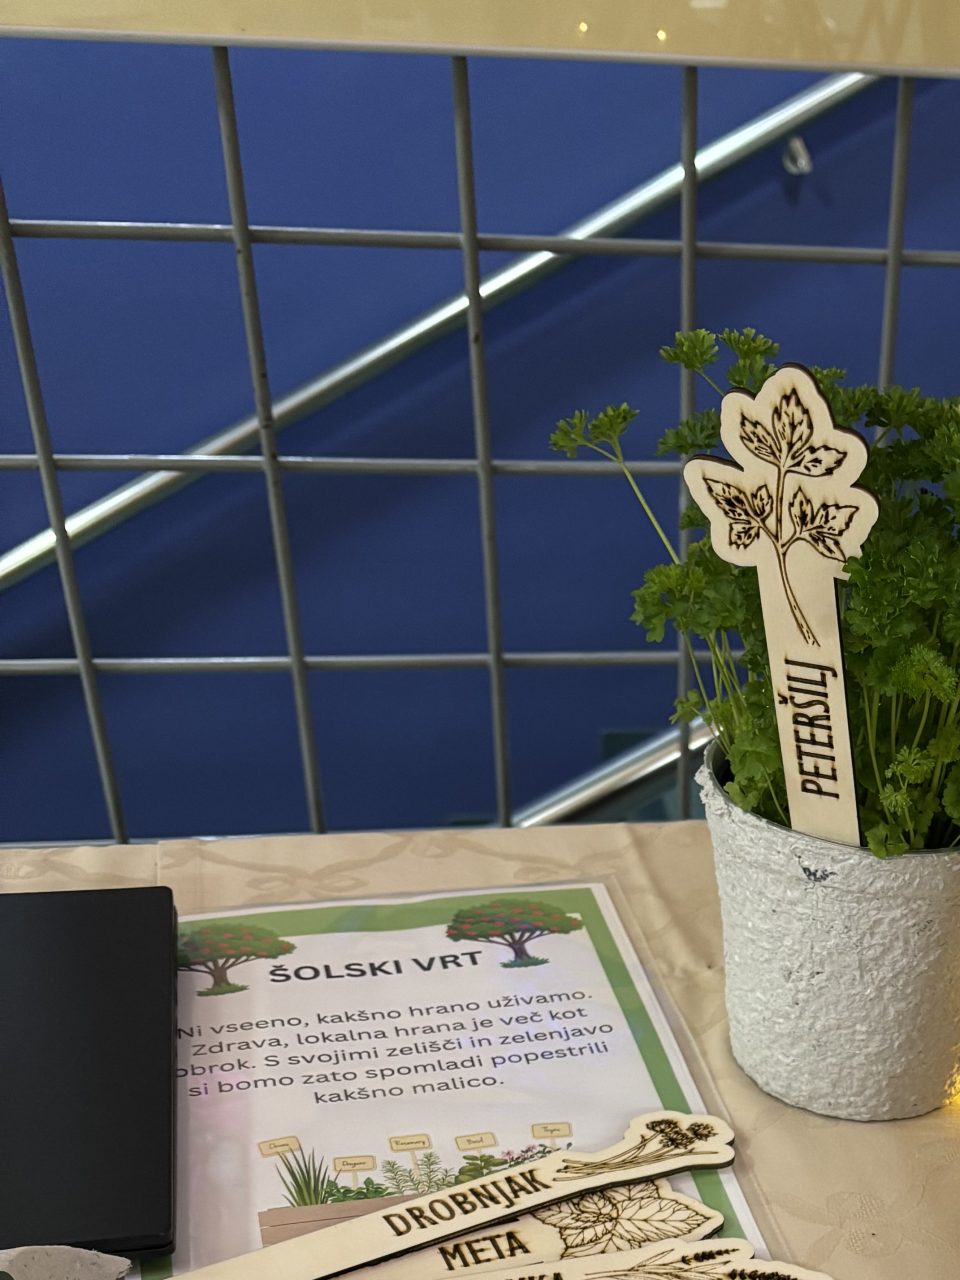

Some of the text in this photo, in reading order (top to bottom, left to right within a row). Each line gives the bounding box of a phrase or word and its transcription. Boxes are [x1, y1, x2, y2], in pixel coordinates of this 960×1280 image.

[778, 659, 840, 800] PETERŠILJ
[269, 951, 482, 982] ŠOLSKI VRT
[192, 1008, 588, 1056] Zdrava, lokalna hrana je več kot
[210, 1017, 309, 1034] vseeno,
[317, 1010, 401, 1024] kakšno
[408, 1002, 480, 1017] hrano
[487, 991, 592, 1008] uživamo.
[264, 1055, 280, 1067] S
[288, 1047, 378, 1065] svojimi
[386, 1038, 462, 1057] zelišči
[469, 1037, 492, 1048] in
[499, 1024, 613, 1045] zelenjavo
[189, 1041, 608, 1096] si bomo zato spomladi popestrili
[314, 1077, 504, 1104] kakšno malico.
[382, 1168, 552, 1237] DROBNJAK
[438, 1230, 530, 1271] META
